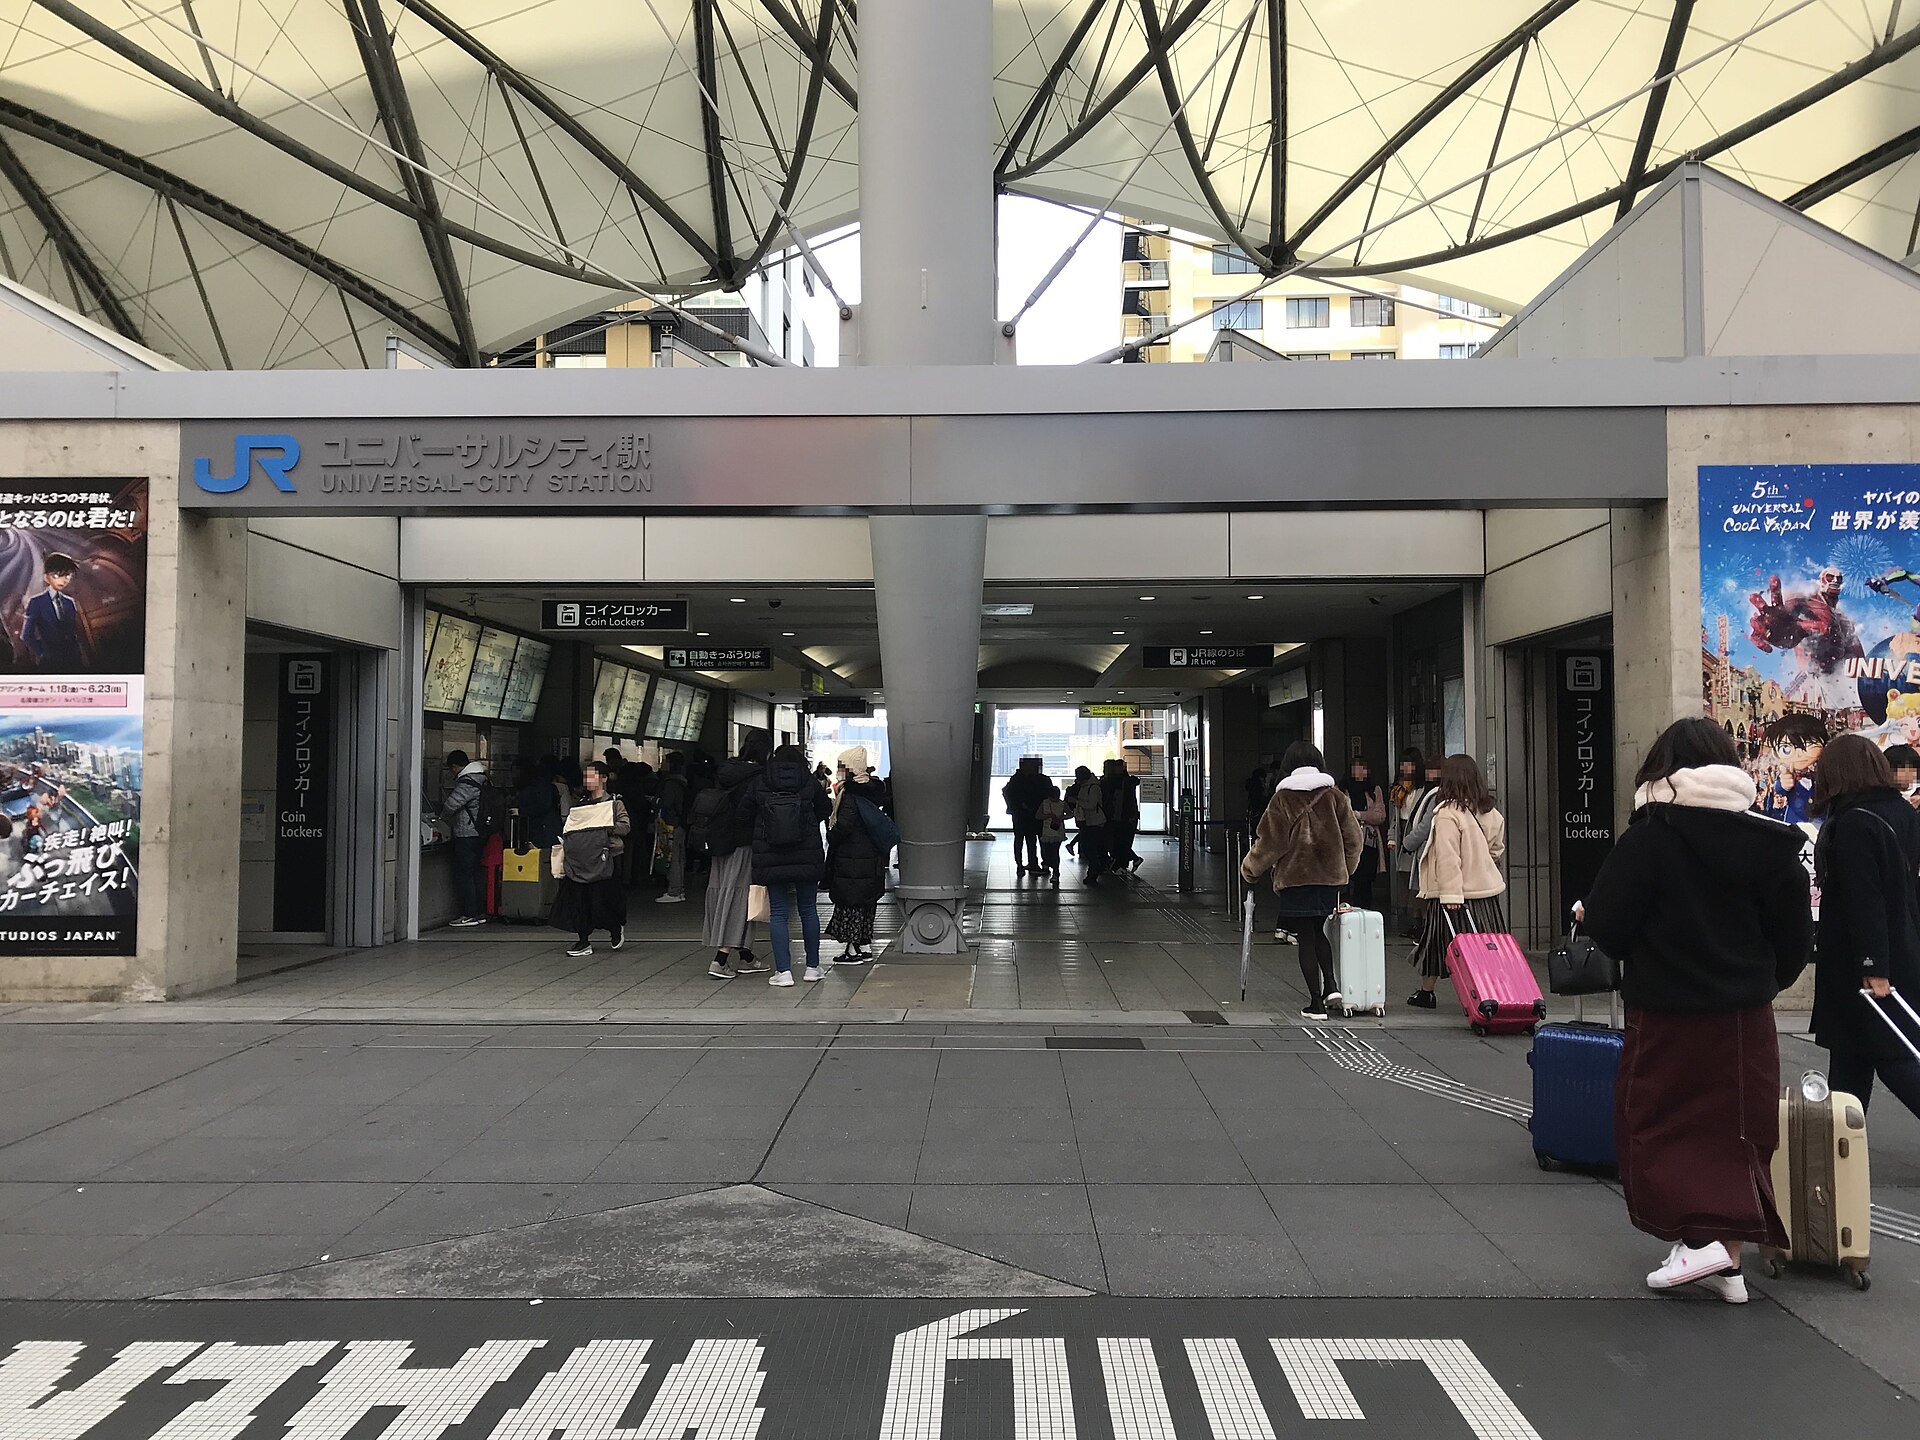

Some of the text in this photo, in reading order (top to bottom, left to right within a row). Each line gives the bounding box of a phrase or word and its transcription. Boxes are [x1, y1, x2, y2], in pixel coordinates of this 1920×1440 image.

[321, 433, 651, 469] ユニバーサルシティ駅
[194, 433, 300, 493] JR
[321, 474, 651, 493] UNIVERSAL-CITY STATION
[1863, 491, 1920, 505] ヤバイの
[1732, 503, 1804, 515] UNIVERSAL
[585, 604, 672, 616] コインロッカー
[584, 617, 645, 626] Coin Lockers
[689, 650, 762, 660] 自動きっぷうりば
[1190, 658, 1217, 666] JR Line
[294, 701, 312, 808] コインロッカー
[1576, 698, 1594, 808] コインロッカー
[281, 811, 306, 823] Coin
[1565, 811, 1591, 824] Coin
[281, 826, 323, 838] Lockers
[1565, 827, 1610, 839] Lockers
[6, 840, 123, 889] ぶっ飛び
[64, 931, 116, 941] JAPAN
